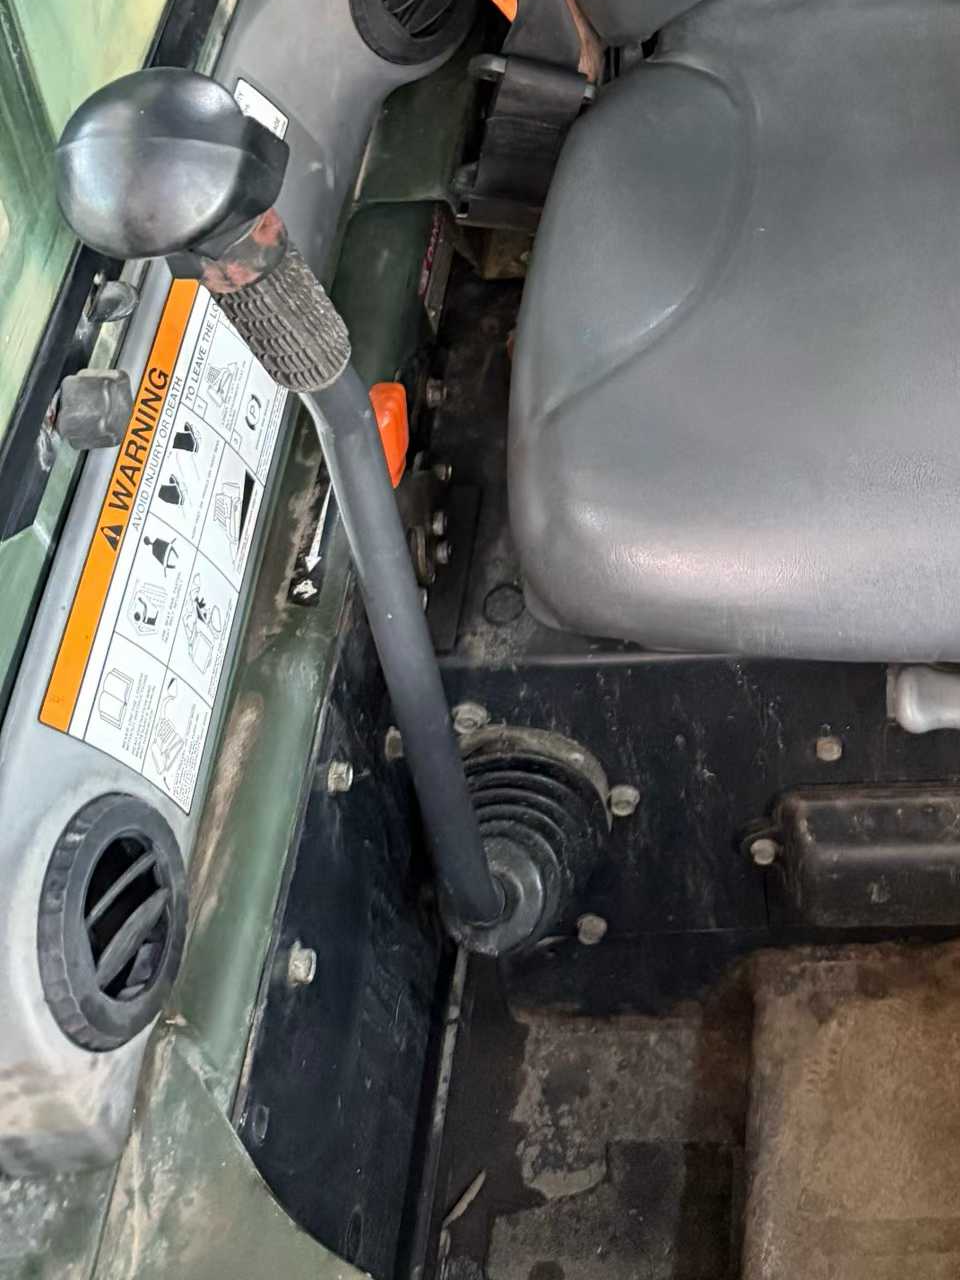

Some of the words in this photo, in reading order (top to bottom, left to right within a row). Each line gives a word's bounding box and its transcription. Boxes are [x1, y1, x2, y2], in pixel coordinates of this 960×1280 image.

[185, 385, 195, 402] TO
[193, 346, 207, 383] LEAVE
[202, 321, 214, 343] THE
[108, 367, 169, 511] WARNING
[132, 488, 150, 532] AVOID
[144, 441, 164, 490] INJURY
[159, 420, 171, 438] OR
[166, 376, 183, 417] DEATH
